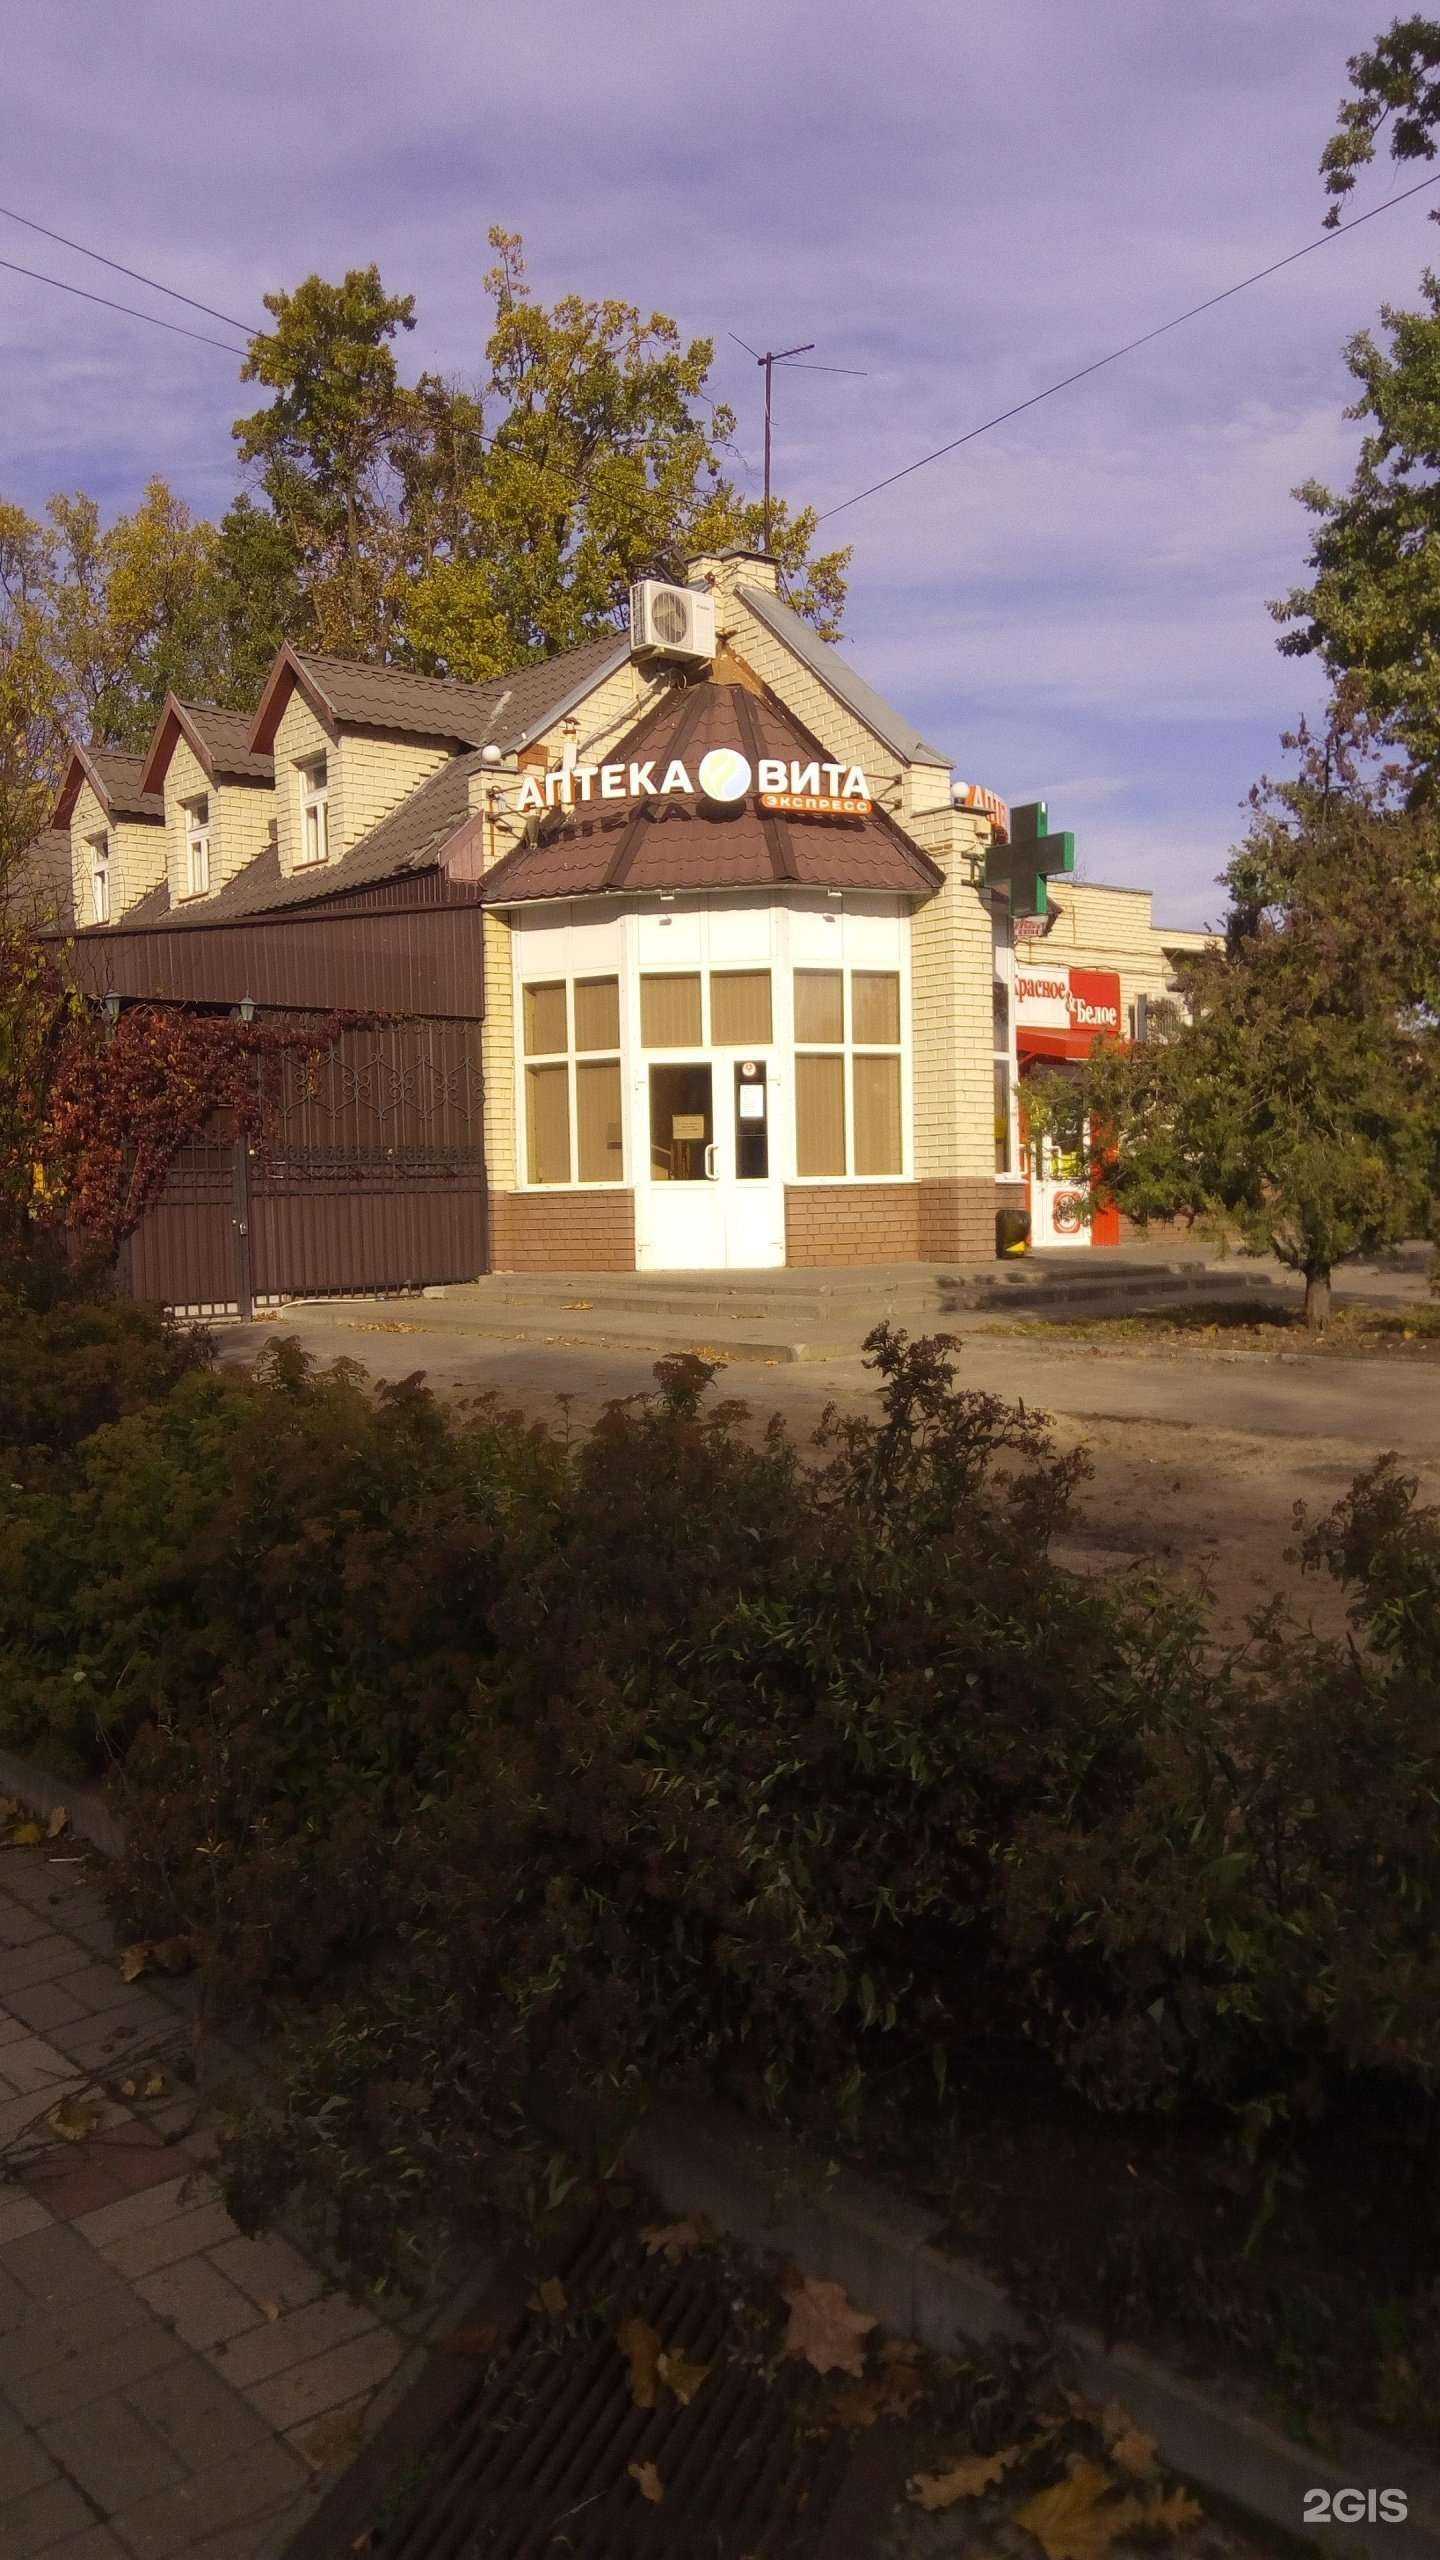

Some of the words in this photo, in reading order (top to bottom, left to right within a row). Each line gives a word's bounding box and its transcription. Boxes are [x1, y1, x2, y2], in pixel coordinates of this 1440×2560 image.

[515, 759, 695, 812] АПТЕКА
[758, 760, 871, 800] ВИТА
[766, 795, 868, 812] ЭКСПРЕСС
[1076, 998, 1117, 1026] Белое
